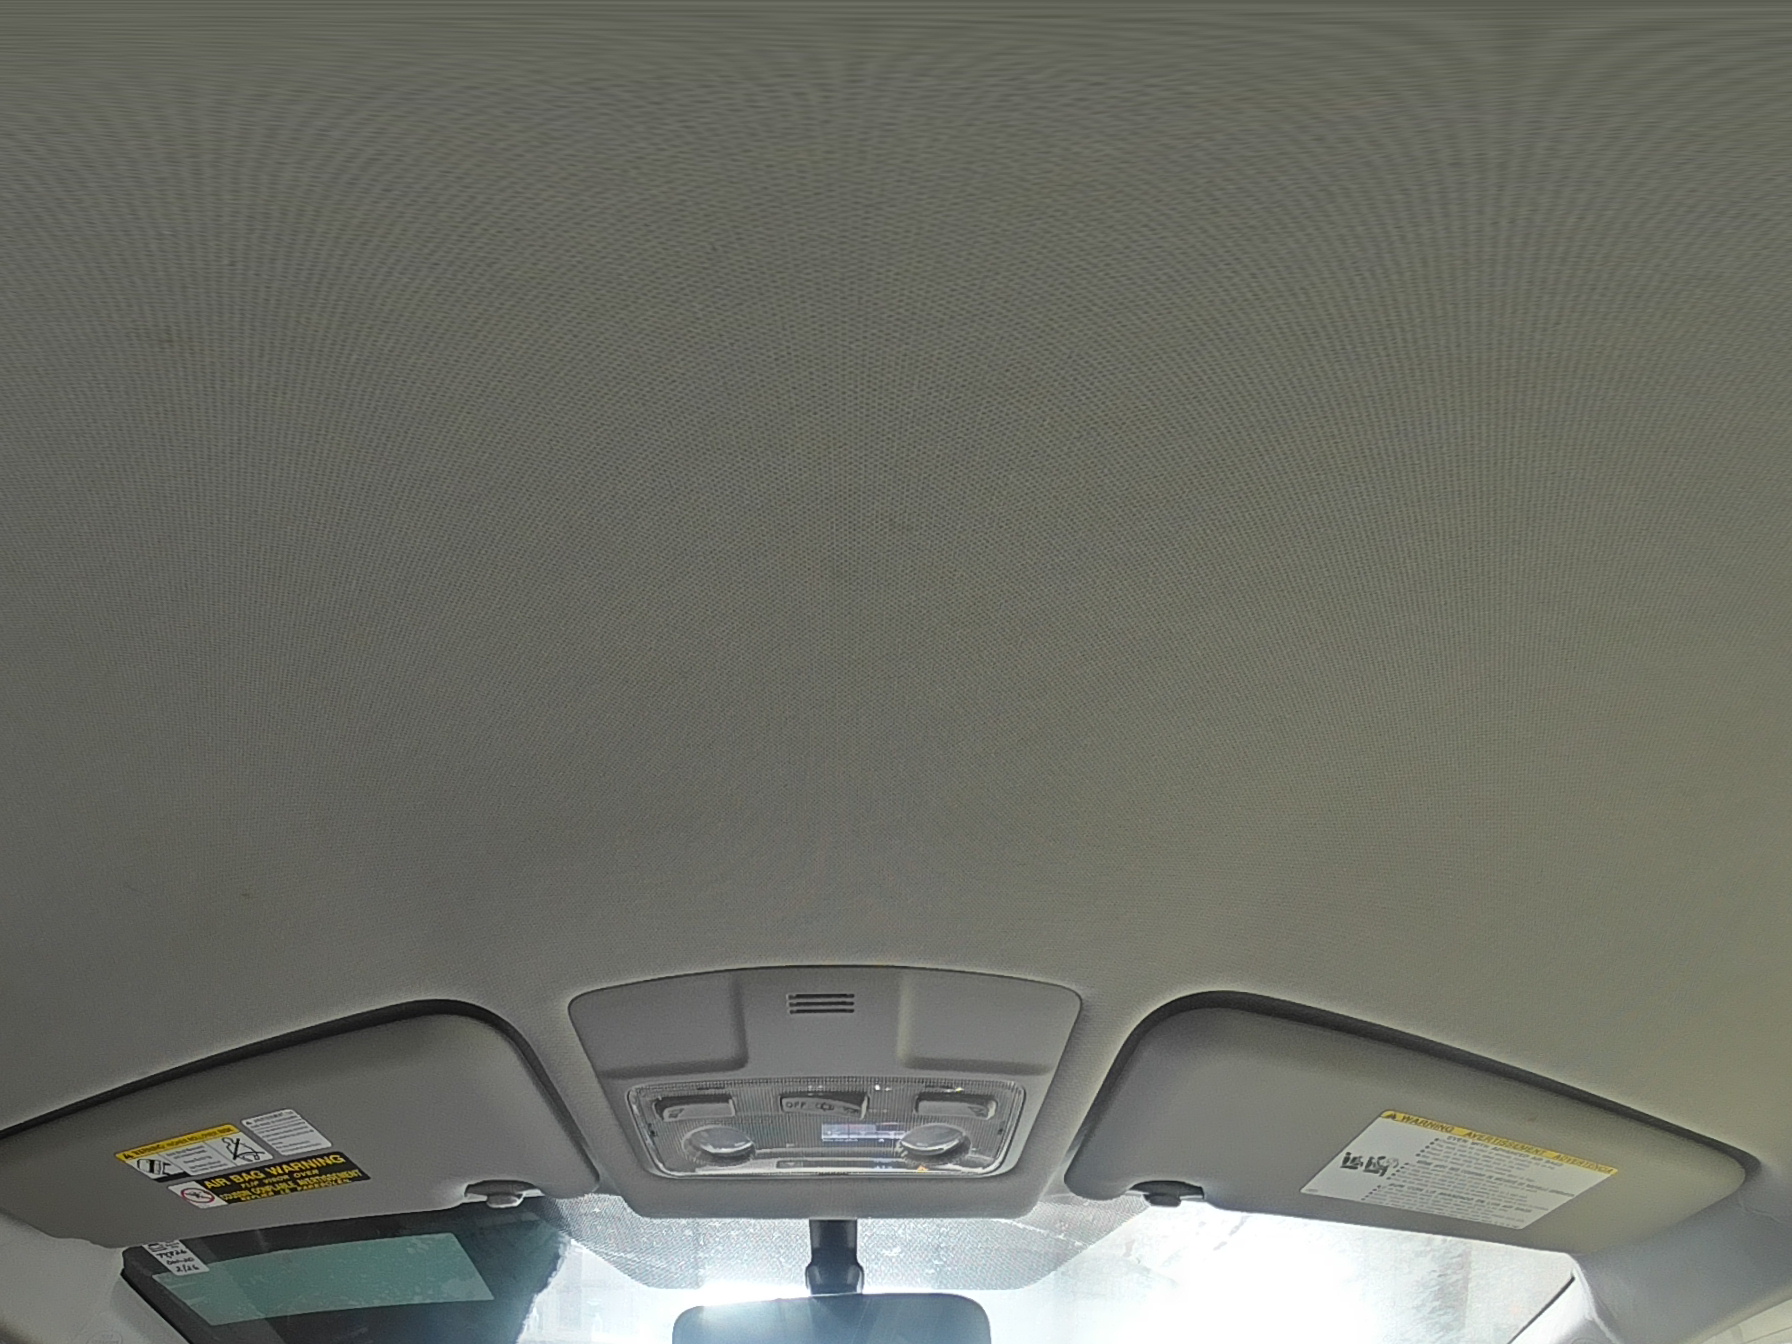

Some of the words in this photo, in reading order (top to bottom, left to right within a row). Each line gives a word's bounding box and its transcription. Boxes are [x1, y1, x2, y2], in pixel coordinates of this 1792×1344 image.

[785, 1101, 806, 1109] OFF
[1400, 1115, 1454, 1134] WARNING
[203, 1177, 230, 1189] AIR
[229, 1170, 266, 1184] BAG
[264, 1154, 346, 1176] WARNING
[293, 1169, 320, 1178] OVER
